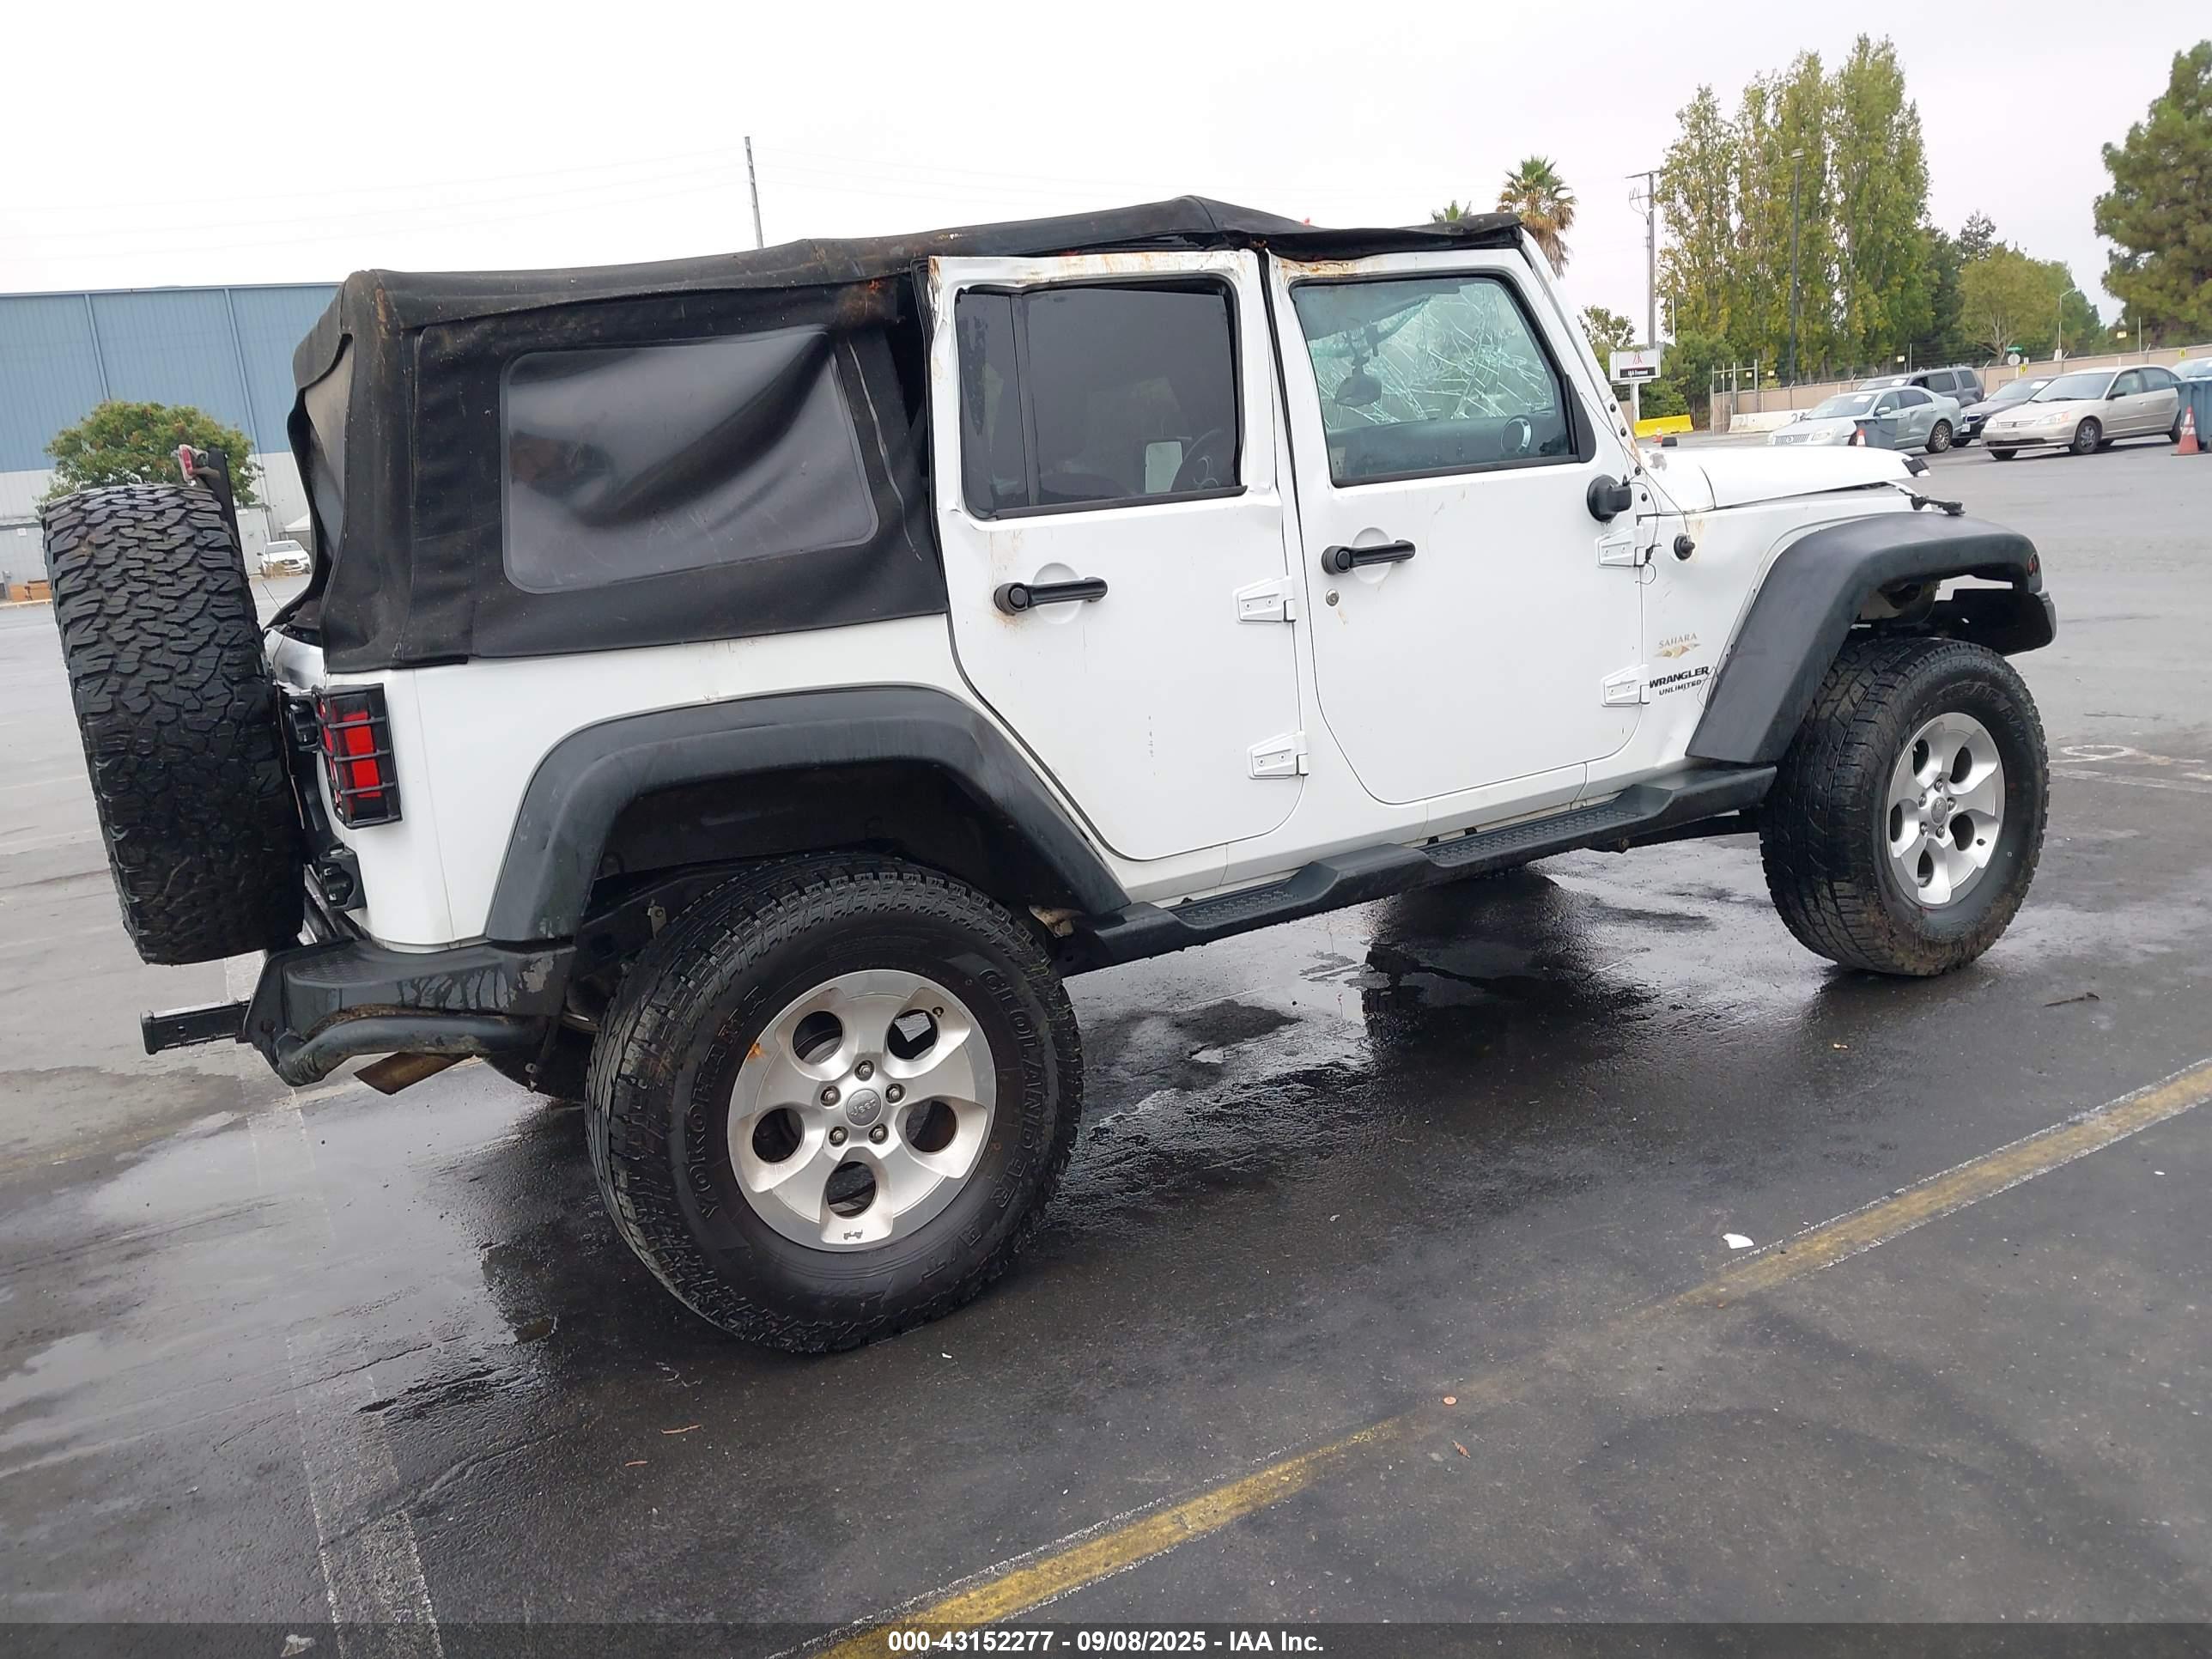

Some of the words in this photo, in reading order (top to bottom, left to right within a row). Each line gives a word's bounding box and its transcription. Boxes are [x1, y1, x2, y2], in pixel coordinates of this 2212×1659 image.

[1658, 632, 1698, 649] SAHARA
[1649, 666, 1709, 689] WRANGLER
[1659, 679, 1702, 696] UNLIMITED
